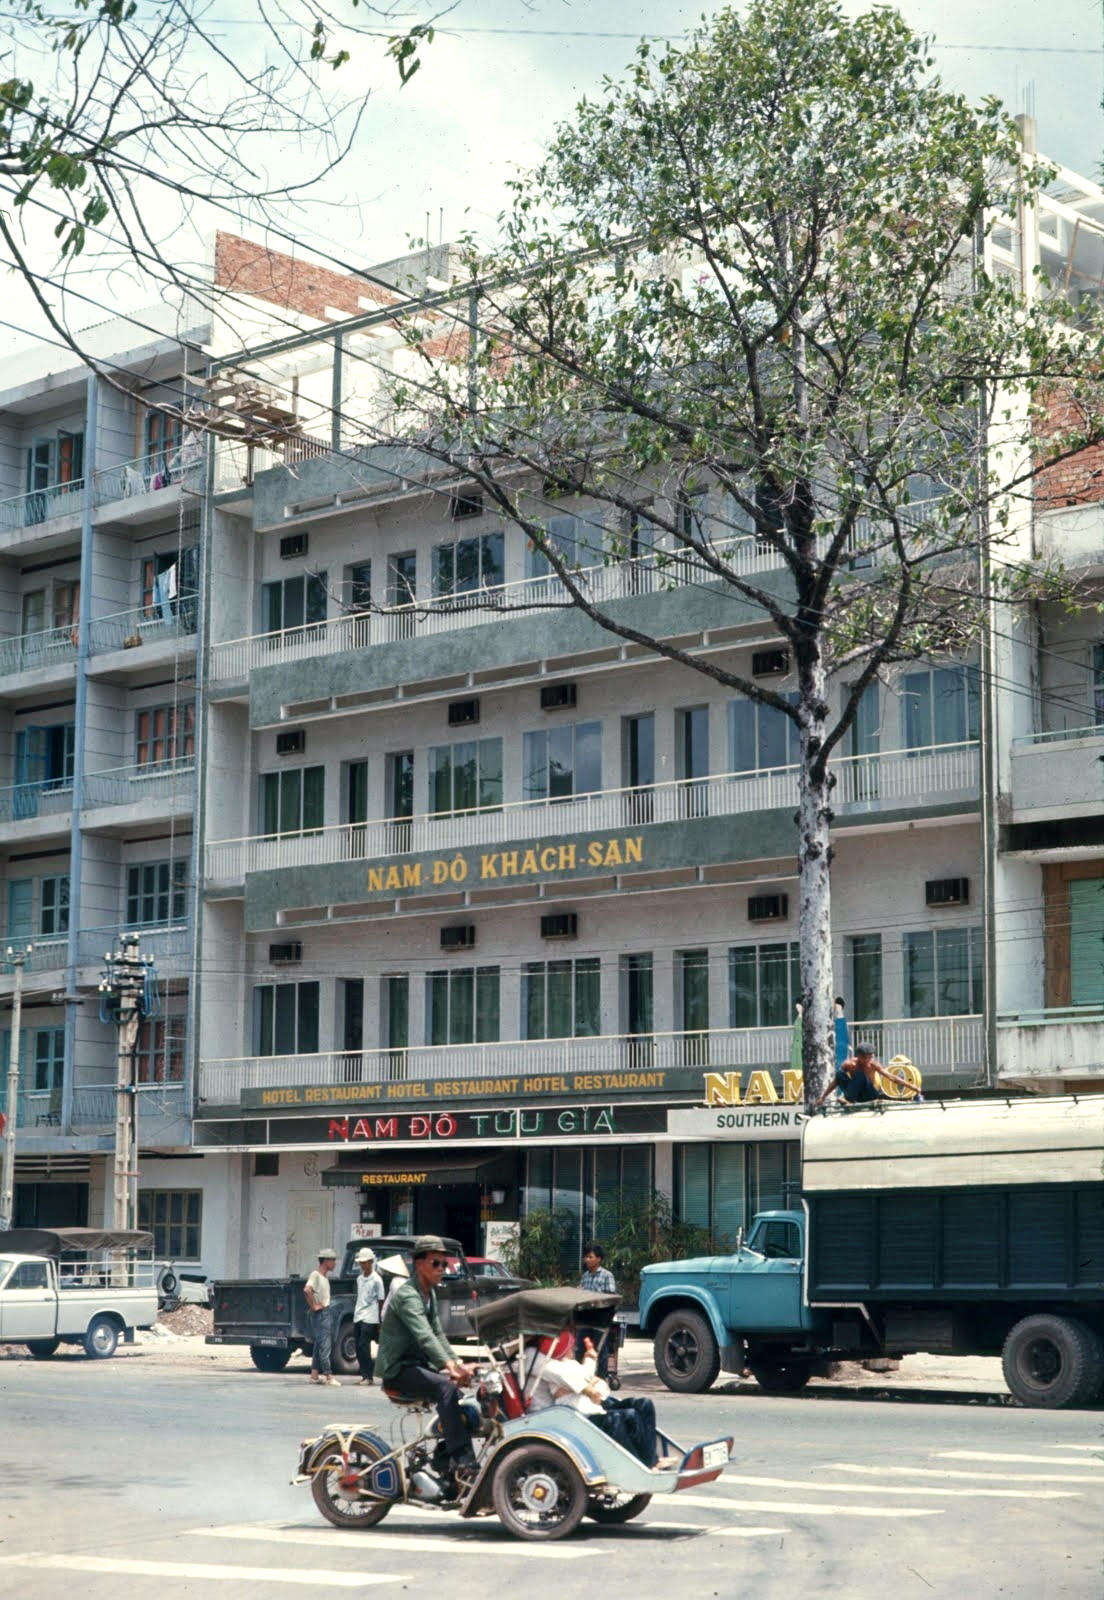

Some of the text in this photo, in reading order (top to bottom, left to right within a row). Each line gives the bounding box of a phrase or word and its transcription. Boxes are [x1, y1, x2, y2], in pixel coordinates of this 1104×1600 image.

[262, 1072, 666, 1104] HOTEL RESTAURANT HOTEL RESTAURANT HOTEL RESTAURANT
[329, 1117, 399, 1140] NAM
[408, 1112, 457, 1137] ĐÔ
[717, 1112, 790, 1128] SOUTHERN
[362, 1173, 428, 1184] RESTAURANT
